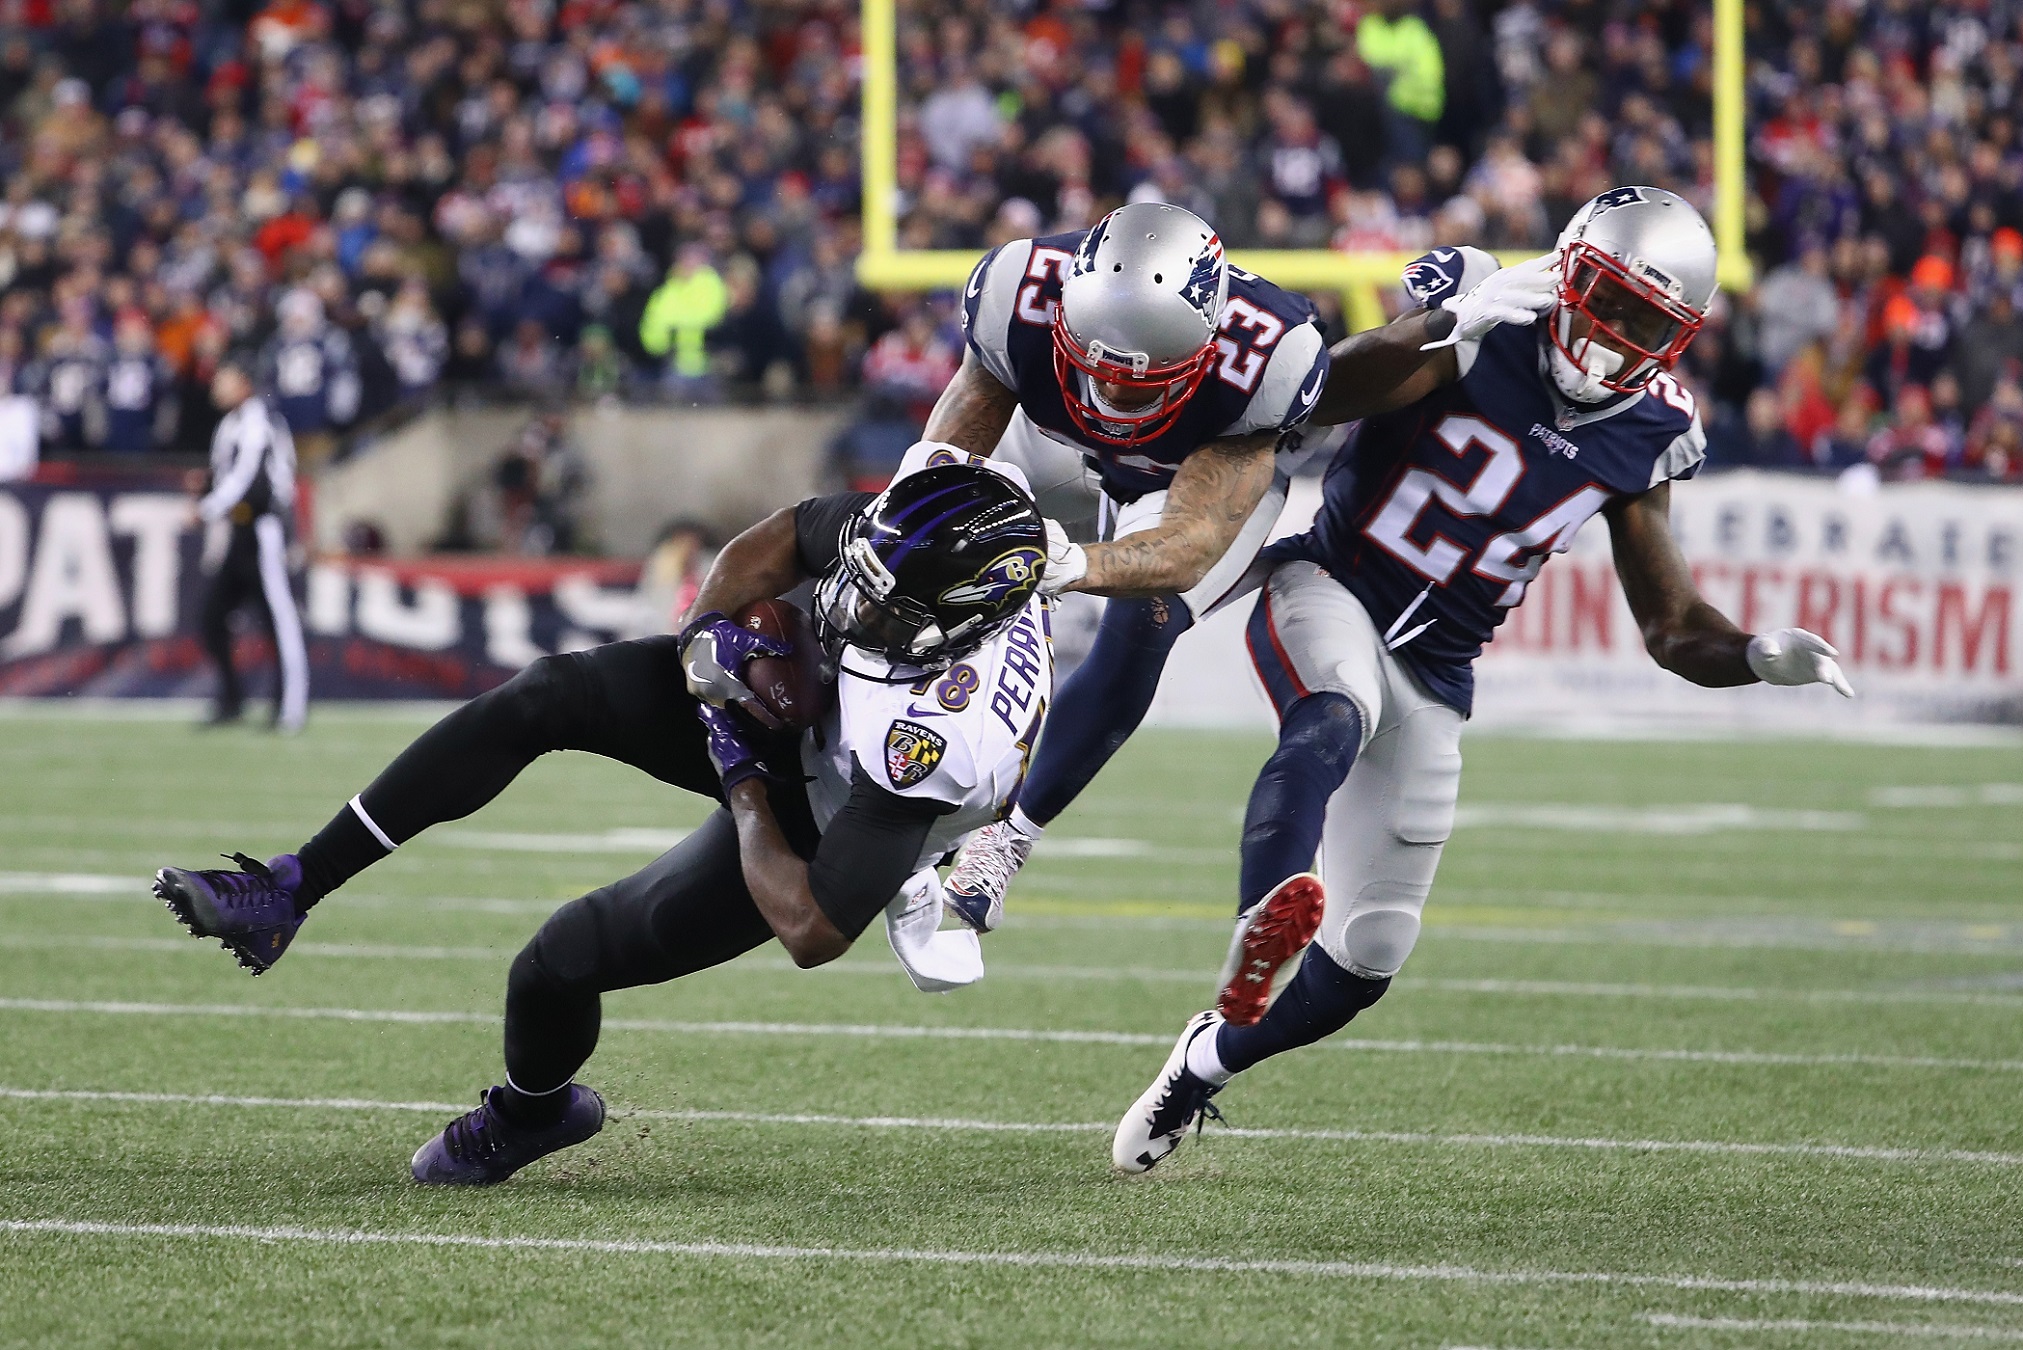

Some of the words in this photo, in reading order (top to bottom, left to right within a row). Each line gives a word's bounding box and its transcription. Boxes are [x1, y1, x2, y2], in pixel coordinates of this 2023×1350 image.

[1207, 296, 1286, 395] 23
[1528, 423, 1580, 460] PATRIOTS
[1361, 411, 1614, 607] 24
[895, 721, 944, 747] RAVENS
